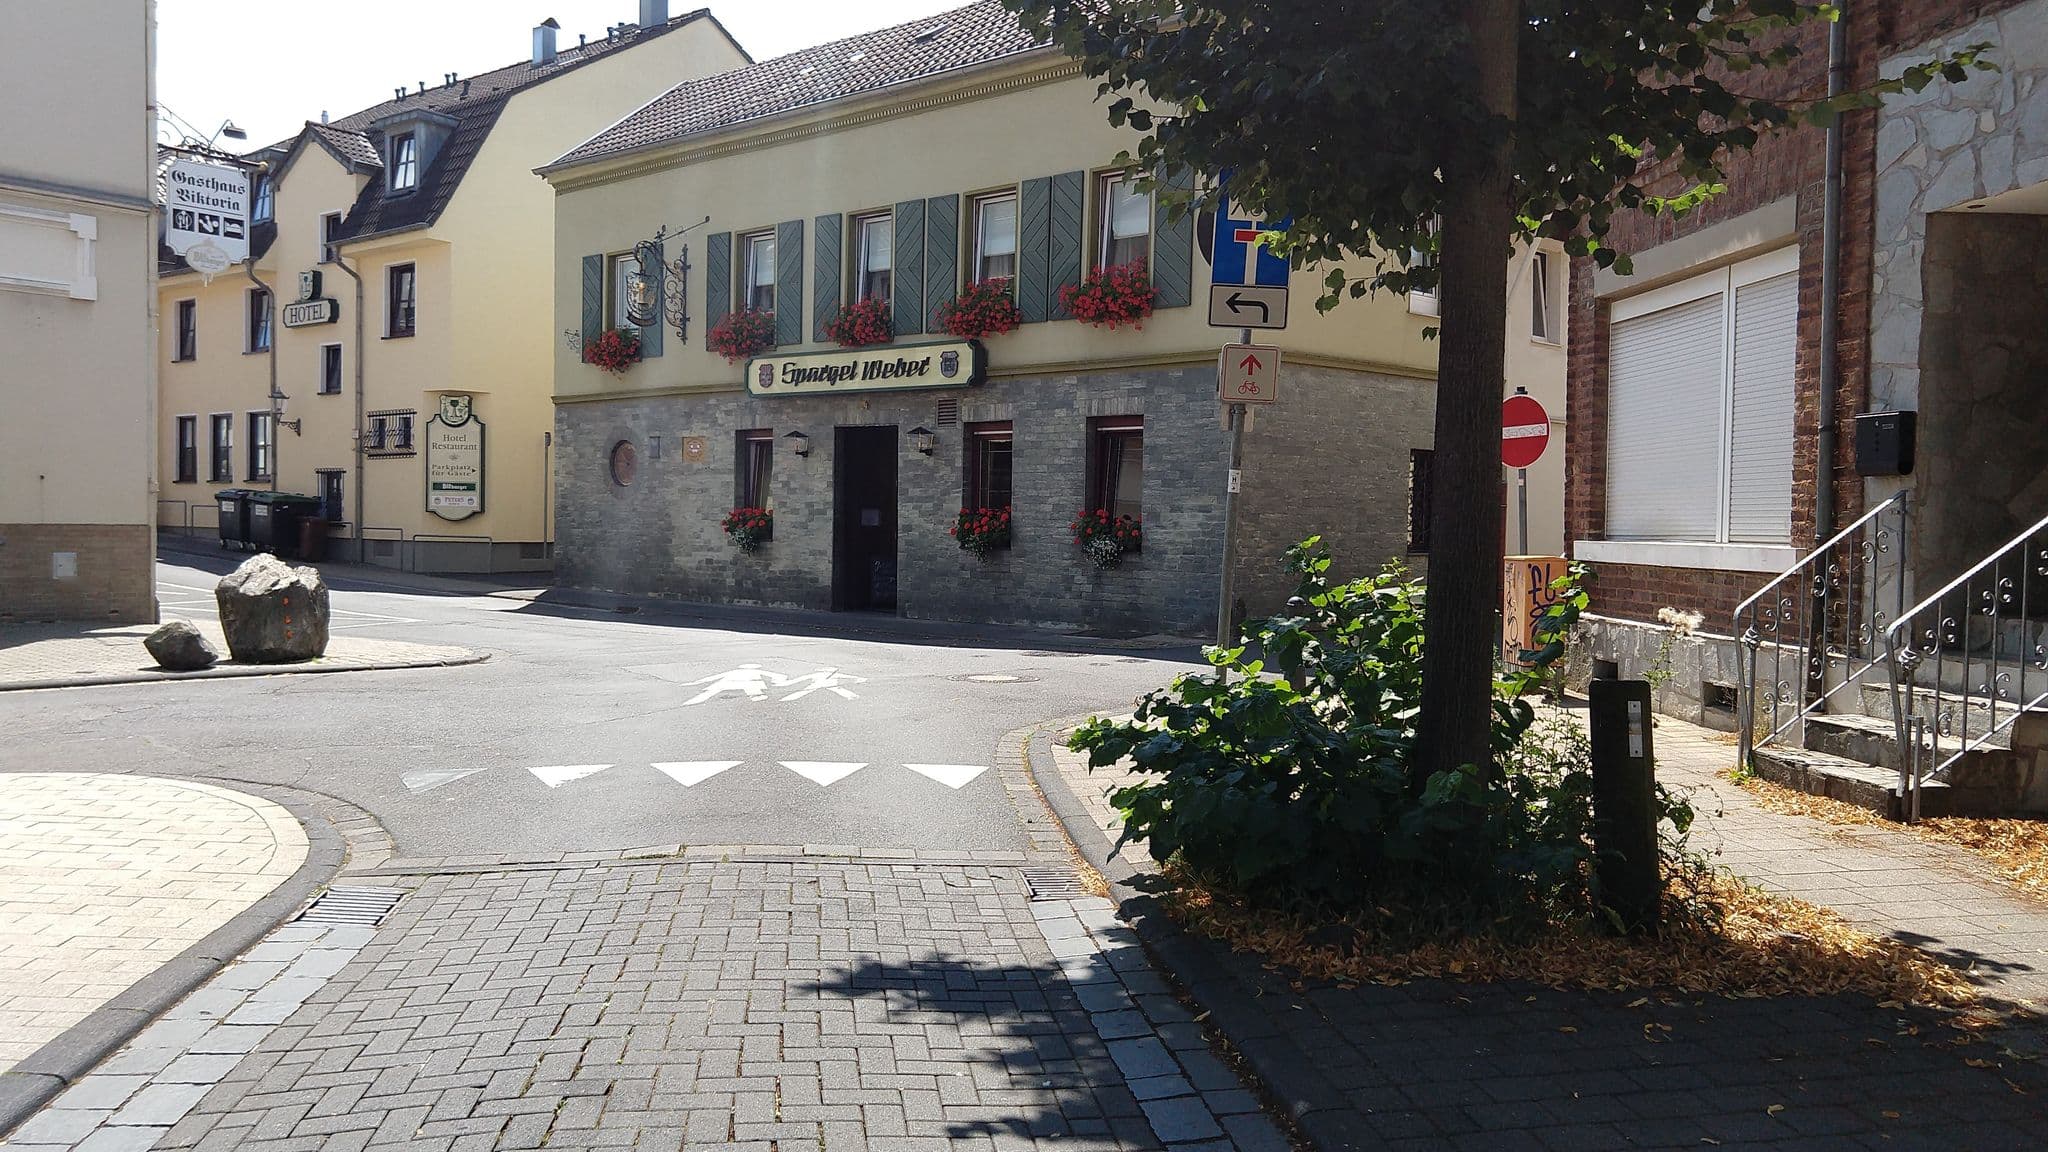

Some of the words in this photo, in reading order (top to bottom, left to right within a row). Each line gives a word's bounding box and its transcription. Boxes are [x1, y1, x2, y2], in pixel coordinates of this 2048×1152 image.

[171, 169, 246, 195] Gasthaus
[176, 188, 240, 211] Viktoria
[290, 303, 325, 323] HOTEL
[781, 360, 858, 387] Spargel
[861, 356, 931, 381] Weber
[432, 442, 477, 450] Restaurant
[443, 434, 466, 442] Hotel
